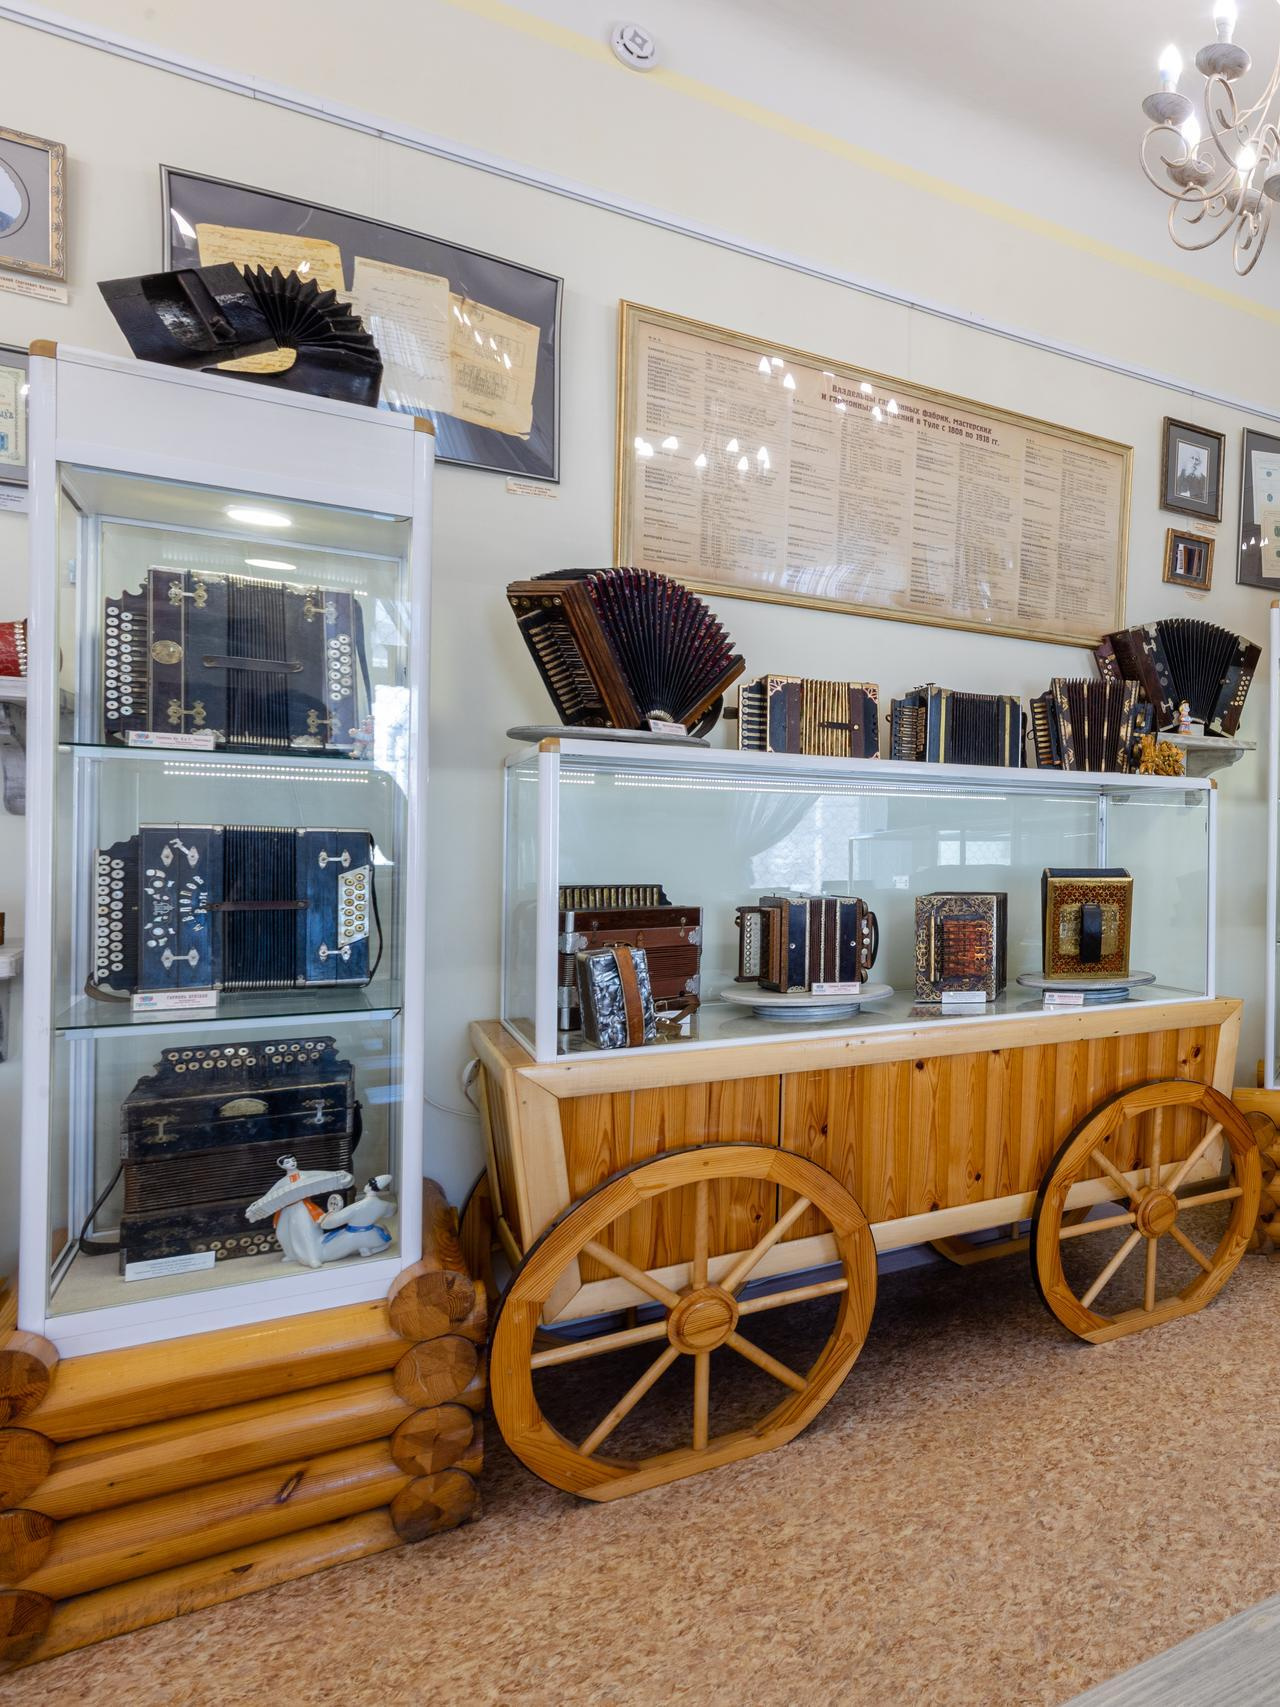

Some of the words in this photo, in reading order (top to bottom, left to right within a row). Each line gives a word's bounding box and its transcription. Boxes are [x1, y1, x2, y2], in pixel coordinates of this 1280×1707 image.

[832, 384, 876, 403] Владельцы
[922, 409, 951, 424] фабрик,
[953, 418, 992, 435] мастерских
[923, 419, 940, 430] Туле
[965, 431, 974, 439] по
[976, 432, 990, 443] 1918
[991, 438, 1001, 446] гг.
